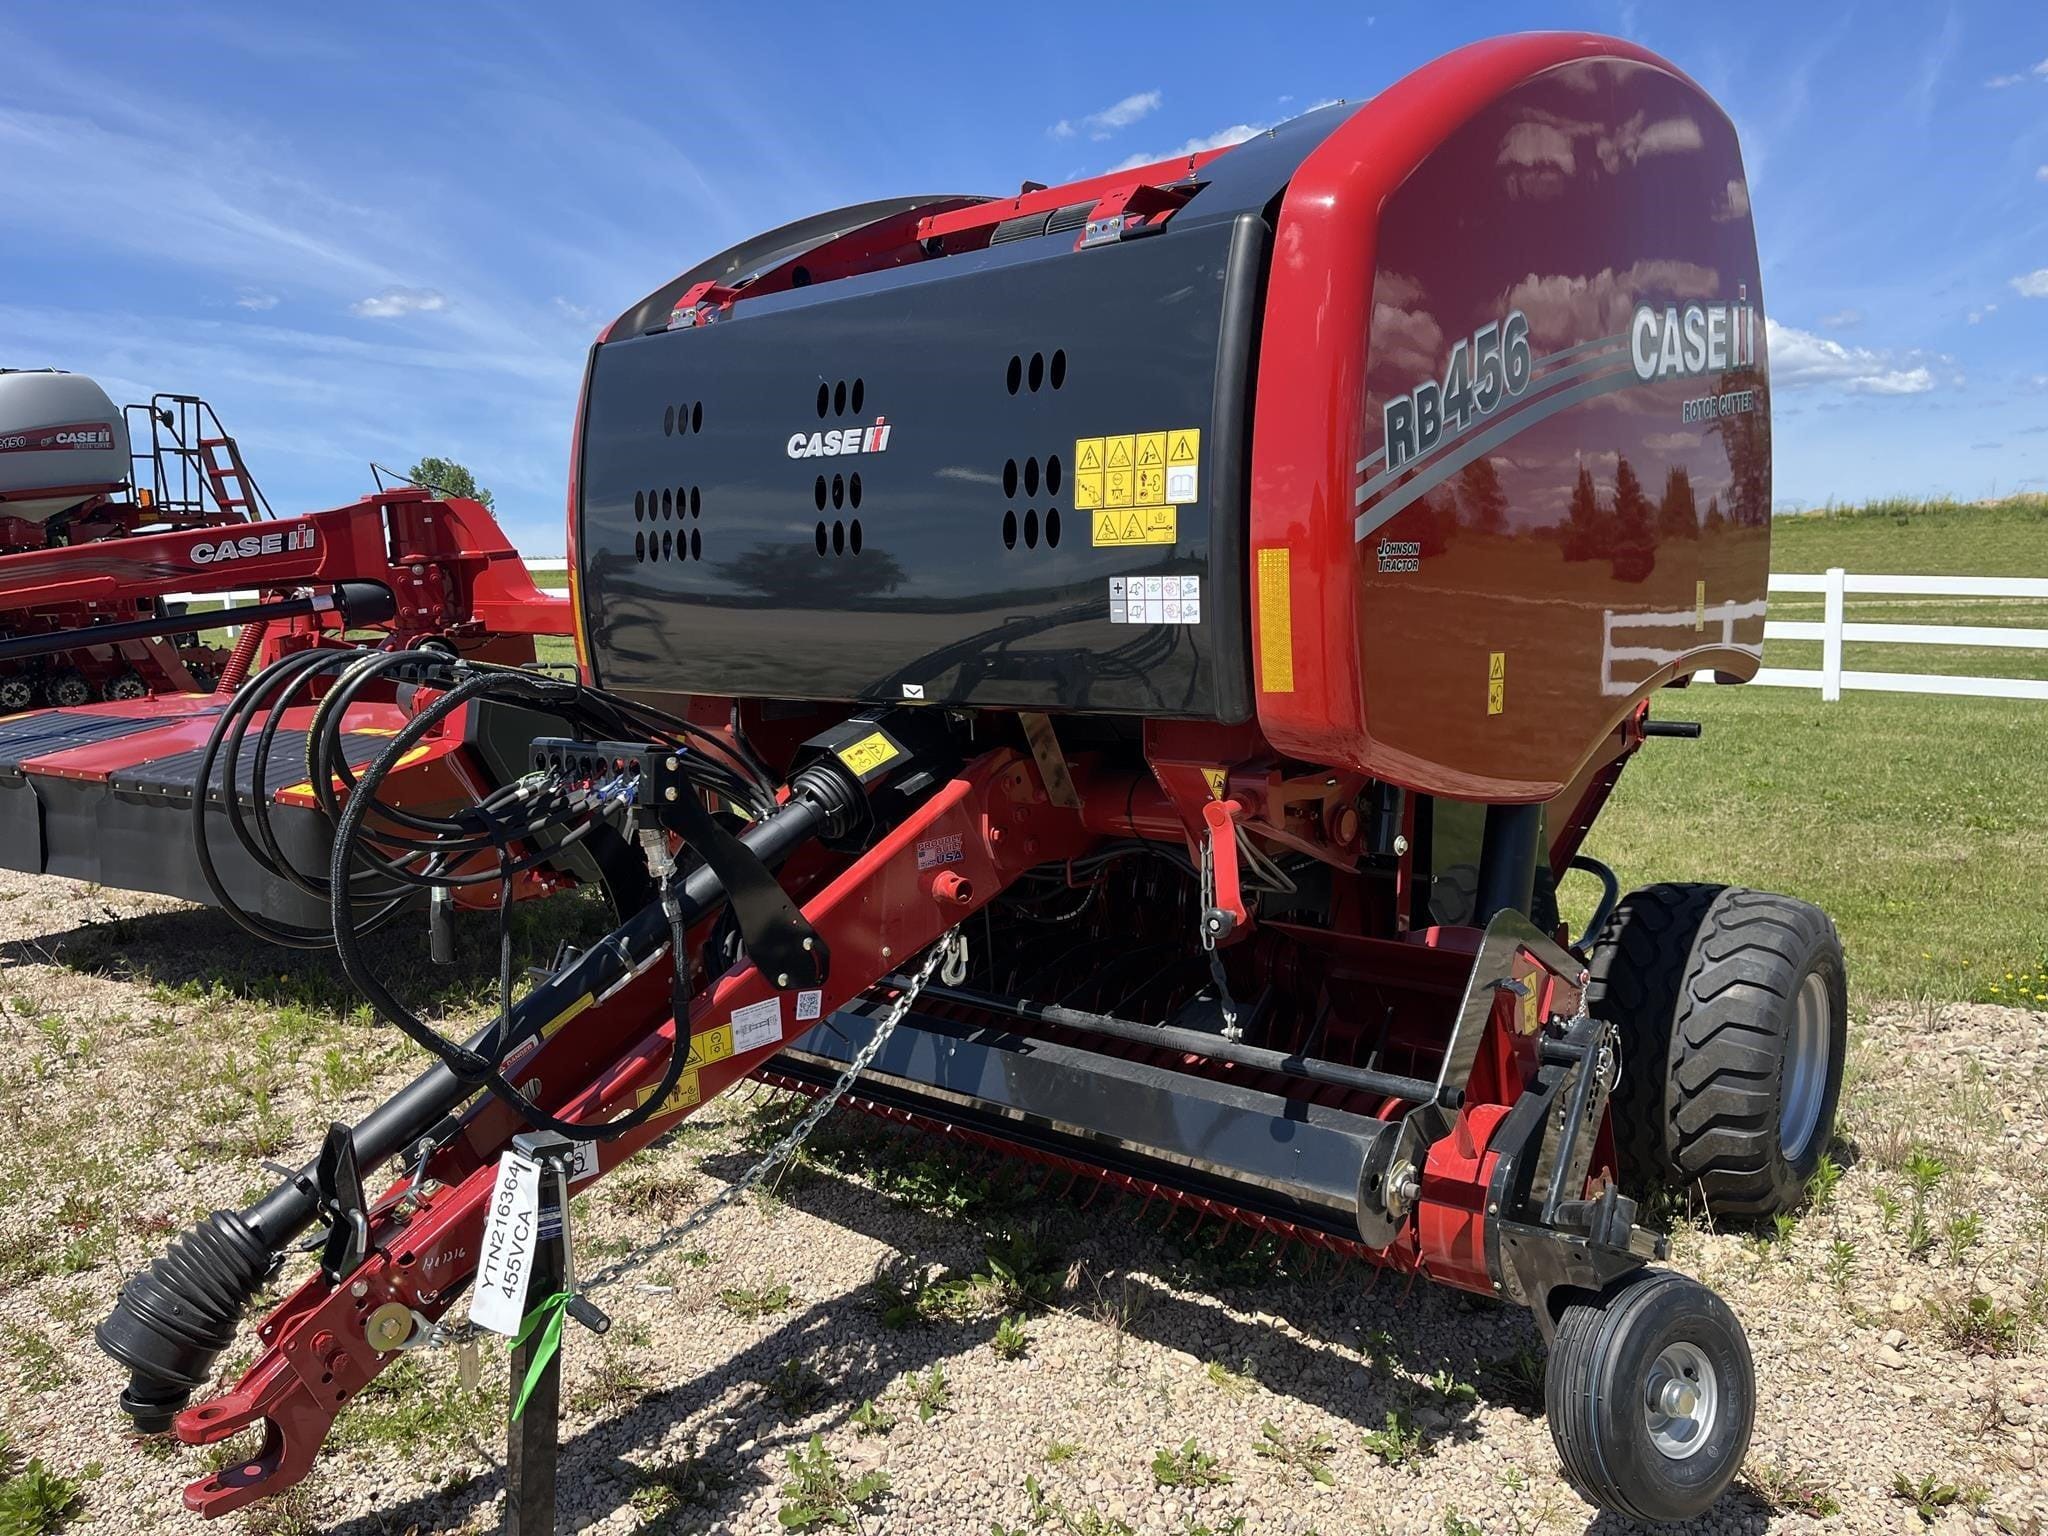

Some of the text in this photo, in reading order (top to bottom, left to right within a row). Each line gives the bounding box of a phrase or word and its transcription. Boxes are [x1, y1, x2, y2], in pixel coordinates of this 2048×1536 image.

[1632, 305, 1727, 380] CASE
[1383, 310, 1531, 475] RB456
[1682, 390, 1753, 424] ROTOR CUTTER
[56, 432, 97, 443] CASE
[787, 428, 863, 459] CASE
[190, 533, 283, 564] CASE
[1377, 538, 1420, 556] JOHNSON
[1378, 555, 1419, 572] TRACTOR
[917, 833, 963, 851] PROUDLY
[936, 851, 962, 864] USA
[506, 1041, 533, 1066] DANGER
[482, 1165, 520, 1289] YTN216364
[502, 1210, 532, 1300] 455VCA
